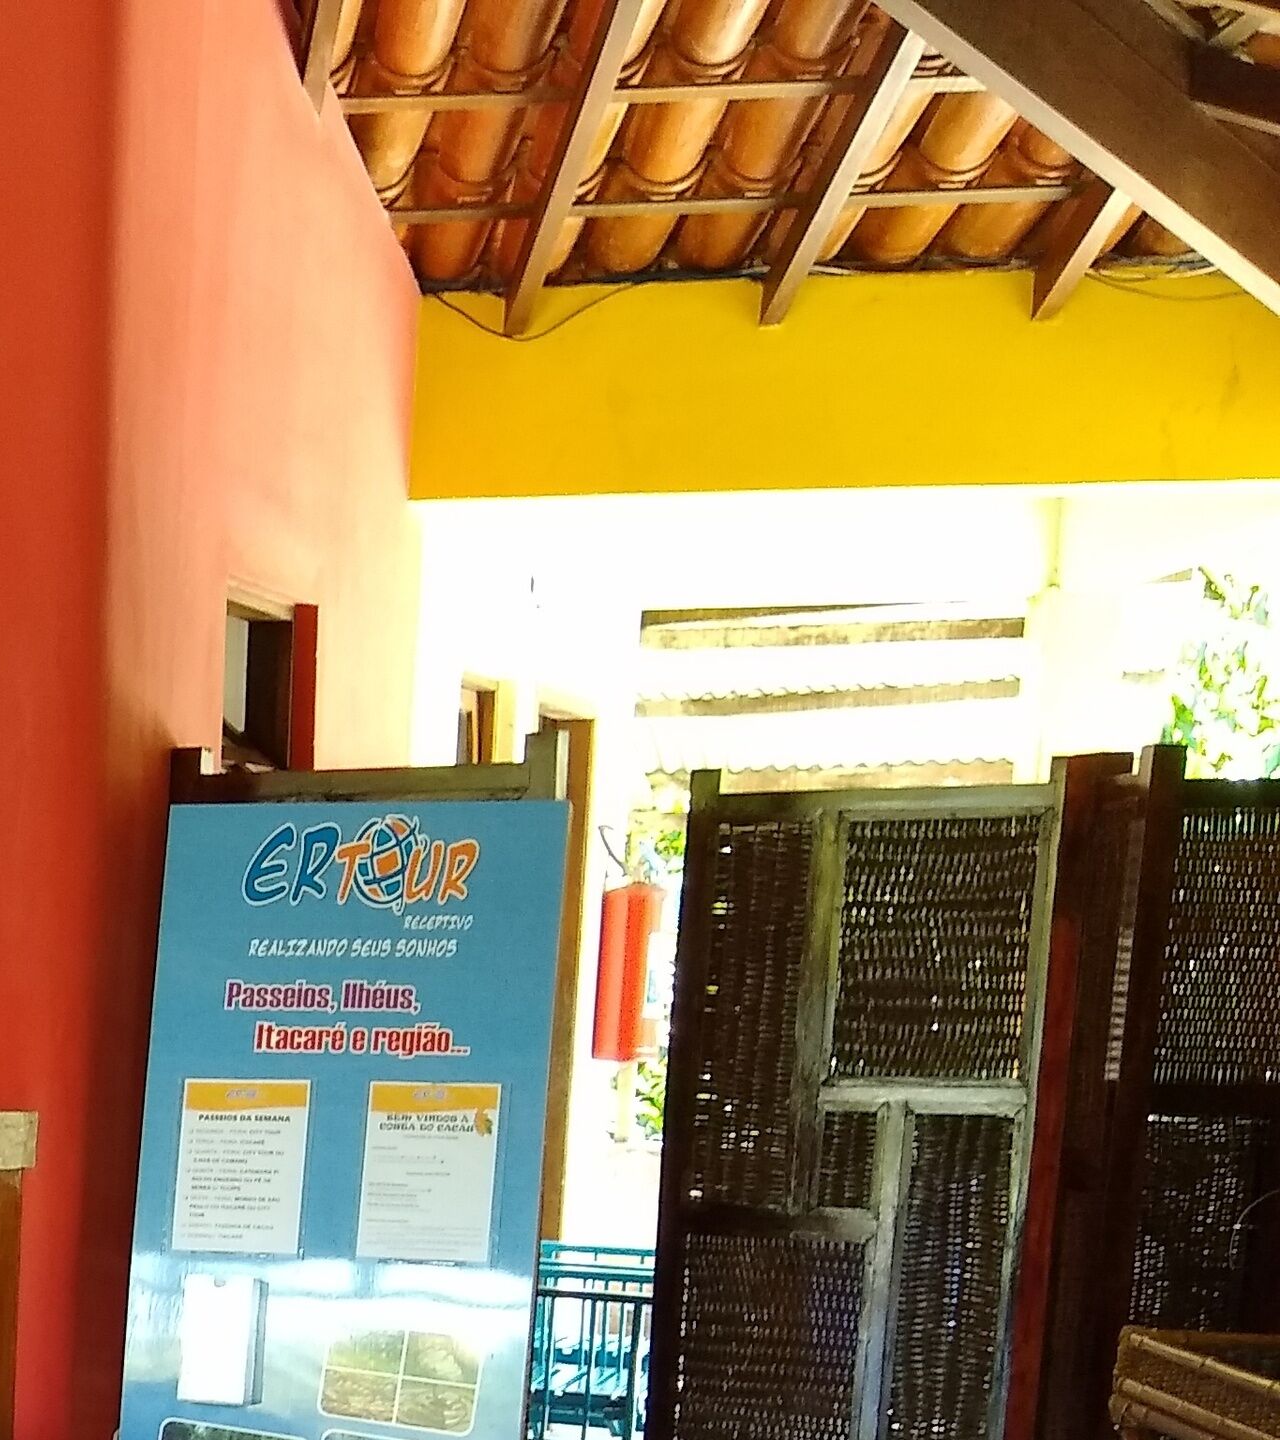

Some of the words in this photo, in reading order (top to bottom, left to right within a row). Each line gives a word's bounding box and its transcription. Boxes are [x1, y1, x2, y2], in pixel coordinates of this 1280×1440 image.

[403, 914, 474, 931] RECEPTIVO
[248, 938, 348, 957] REALIZANDO
[351, 938, 391, 957] SEUS
[395, 938, 458, 958] SONHOS
[225, 980, 337, 1013] Passeios,
[341, 980, 420, 1014] Ilhéus,
[254, 1021, 345, 1053] Itacaré
[350, 1027, 368, 1053] e
[371, 1022, 470, 1059] região...
